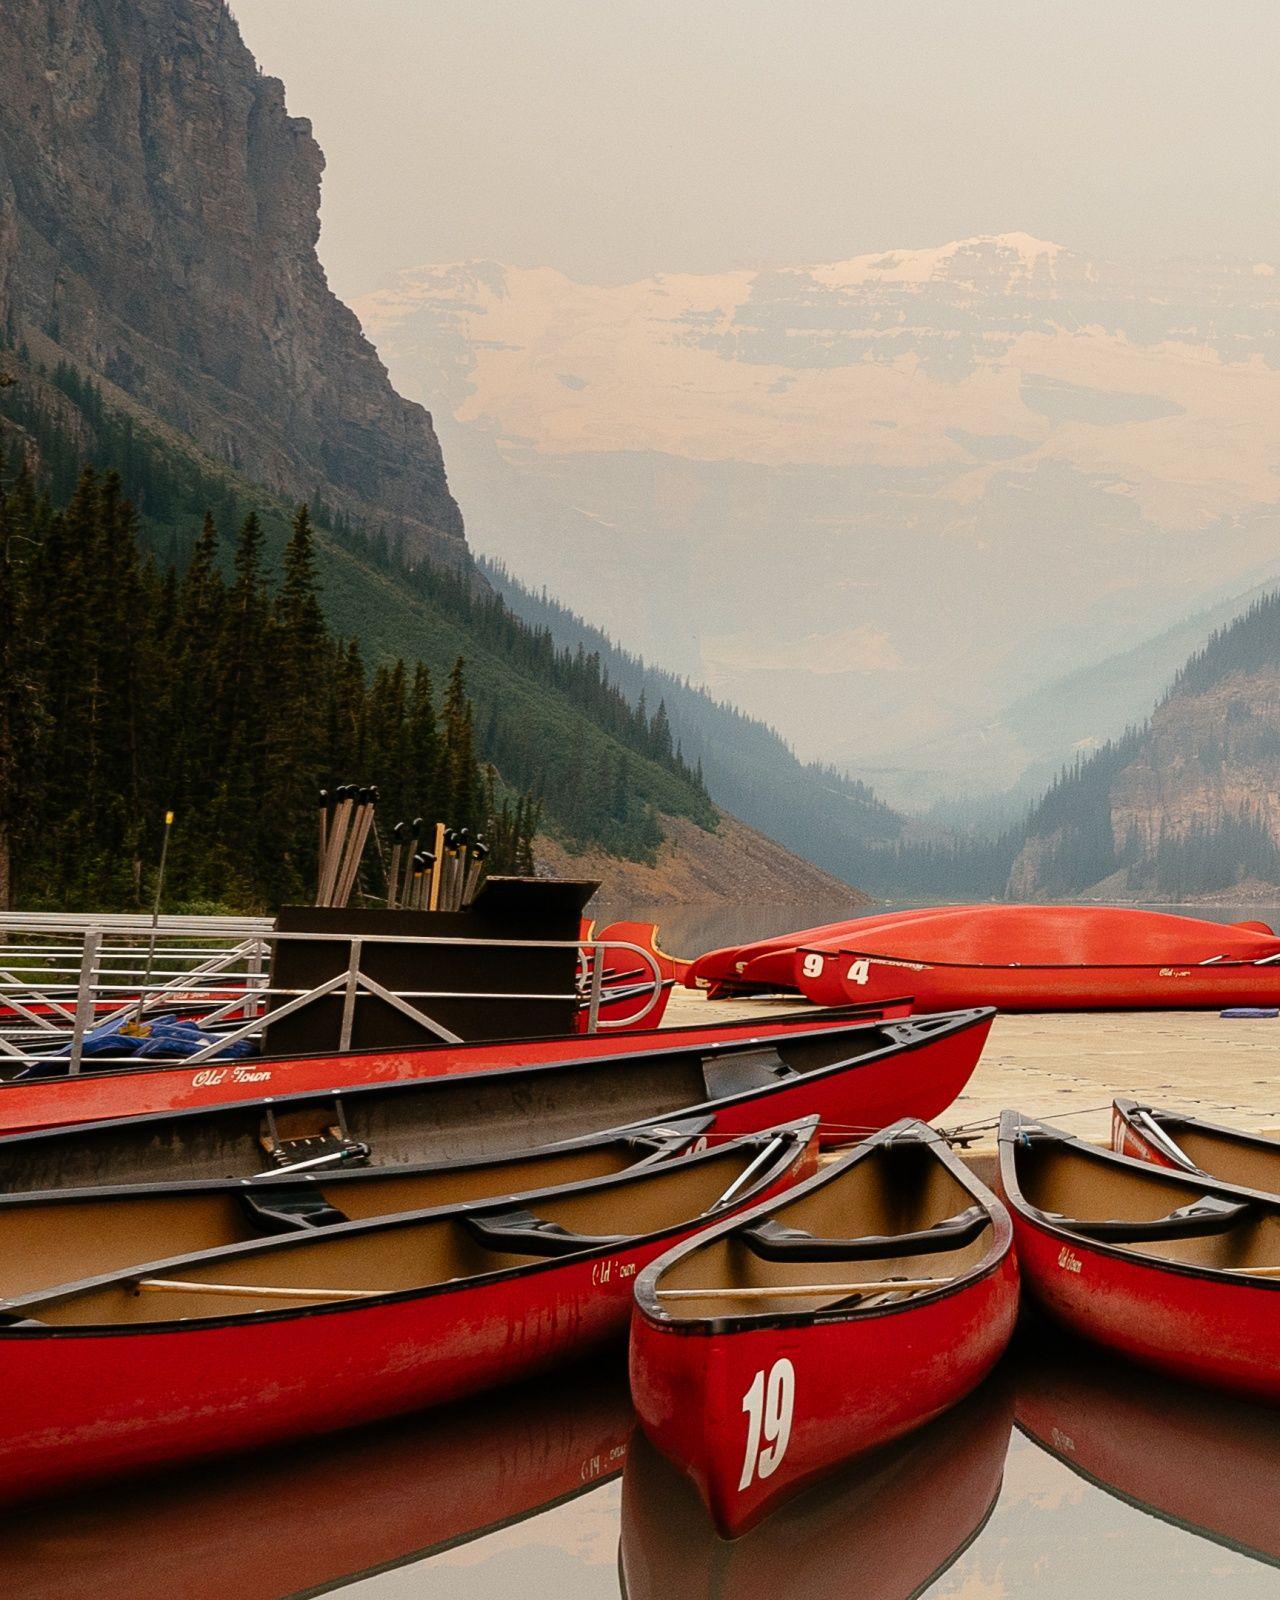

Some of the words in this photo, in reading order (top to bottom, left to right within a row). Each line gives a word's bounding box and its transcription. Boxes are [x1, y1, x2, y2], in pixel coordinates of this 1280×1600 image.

[803, 953, 824, 978] 9
[847, 960, 869, 985] 4
[192, 1069, 228, 1087] Old
[231, 1066, 272, 1083] Town
[737, 1357, 795, 1492] 19
